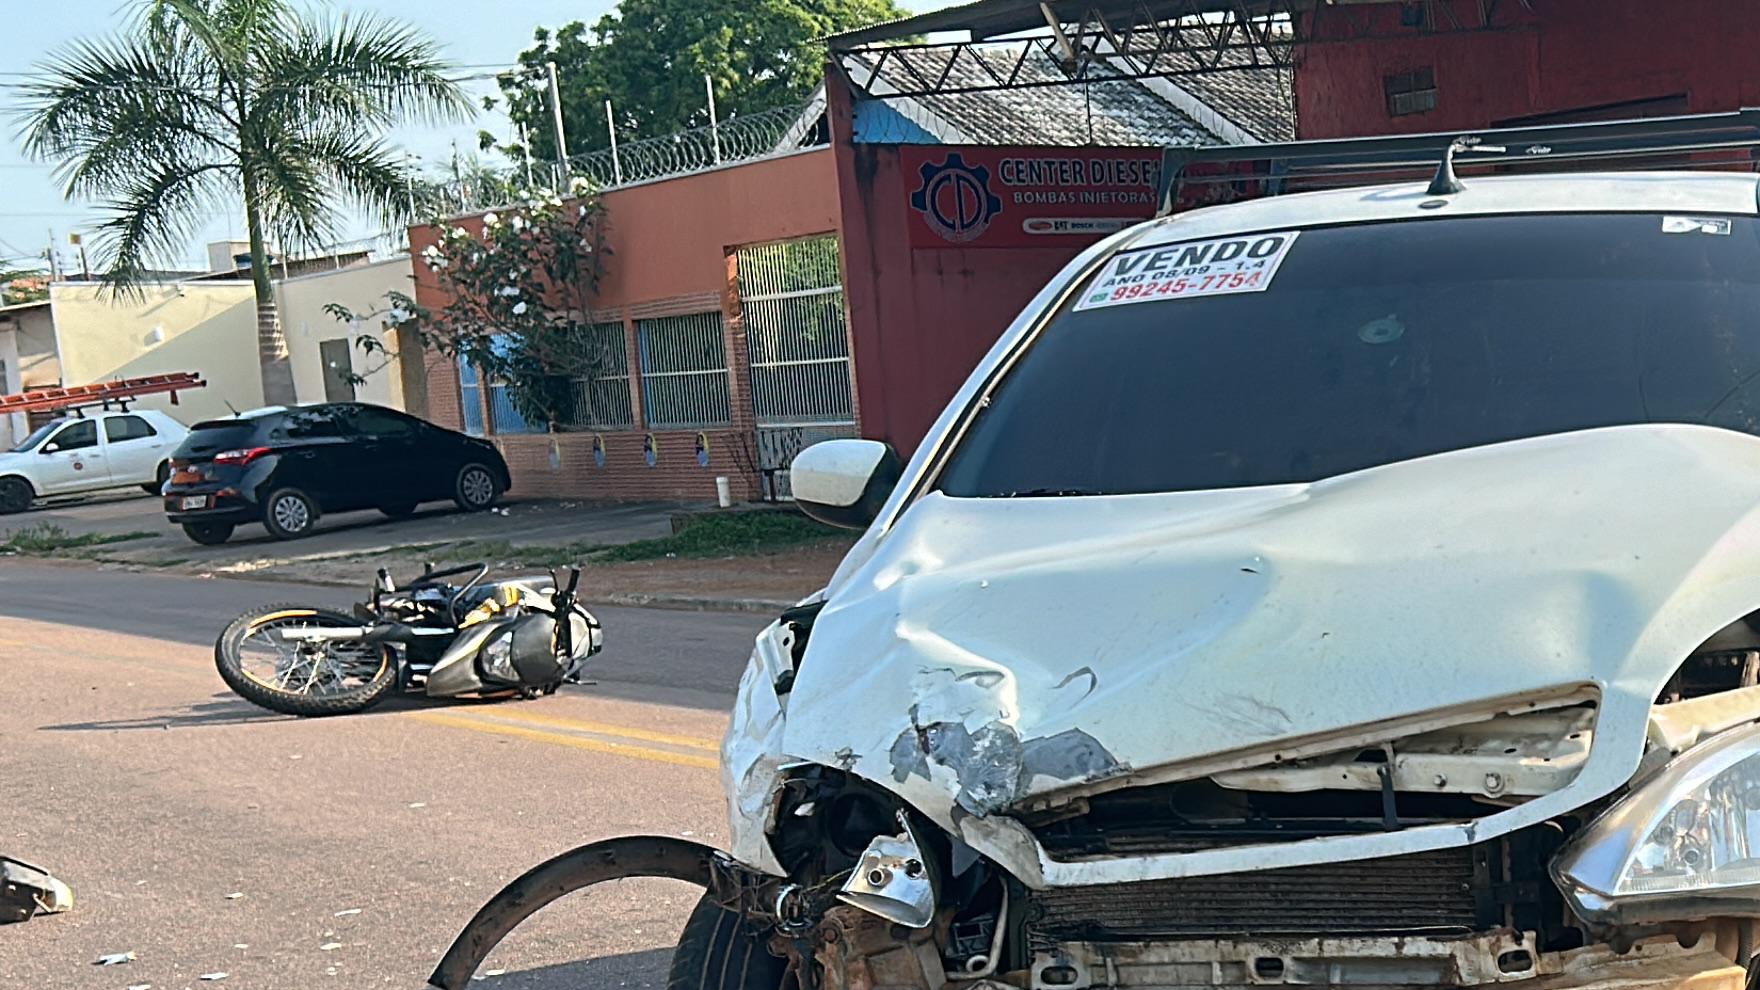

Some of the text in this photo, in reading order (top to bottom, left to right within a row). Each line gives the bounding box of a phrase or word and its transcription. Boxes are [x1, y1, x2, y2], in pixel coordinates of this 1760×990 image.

[1000, 159, 1161, 186] CENTER DIESE
[1014, 191, 1156, 204] BOMBAS INIETORAS
[1114, 236, 1285, 276] VENDO
[1103, 275, 1146, 288] ANO
[1151, 264, 1210, 281] 08/09
[1235, 258, 1266, 271] 1.4
[1110, 270, 1263, 302] 99245-7754
